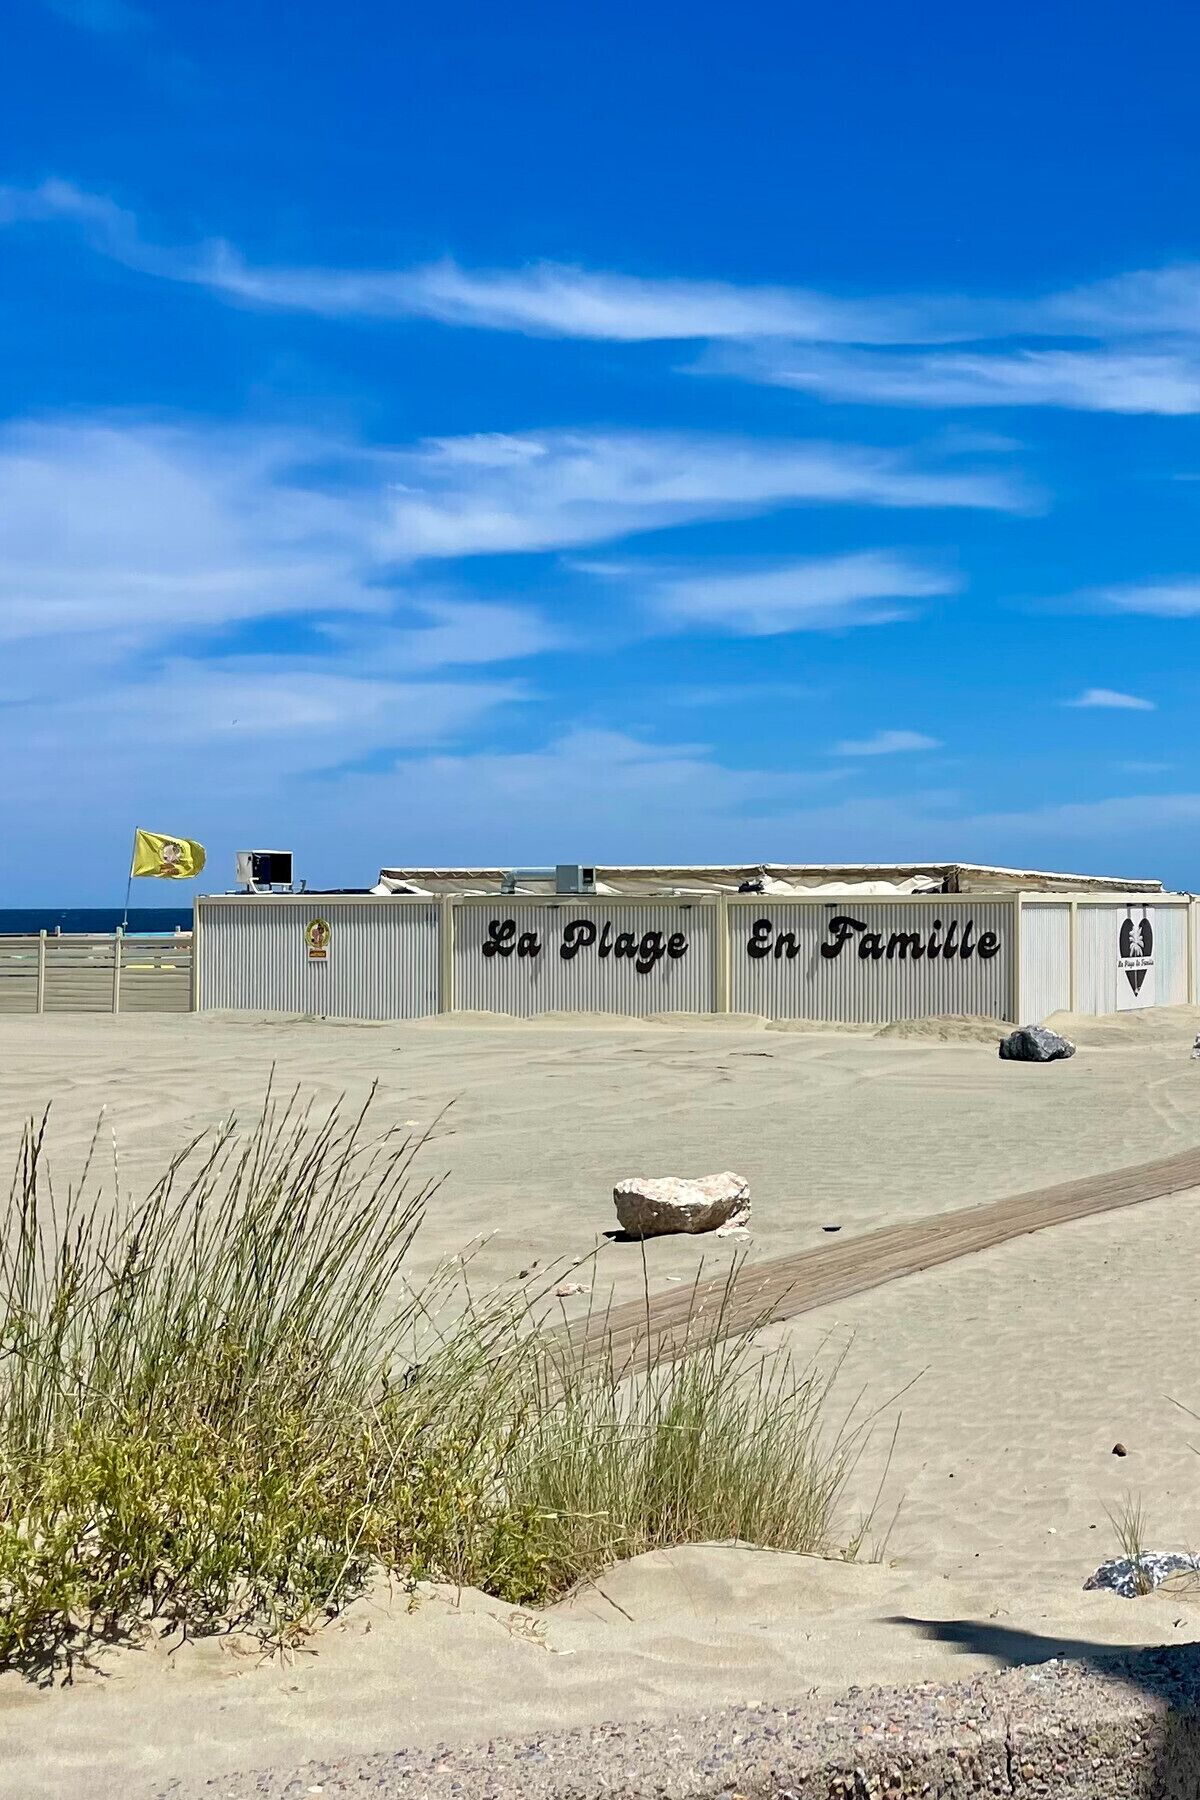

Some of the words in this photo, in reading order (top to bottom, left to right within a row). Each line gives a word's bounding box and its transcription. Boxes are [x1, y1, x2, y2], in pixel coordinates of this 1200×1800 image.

[481, 918, 542, 959] La
[559, 918, 689, 975] Plage
[746, 918, 801, 960] En
[820, 915, 1001, 961] Famille
